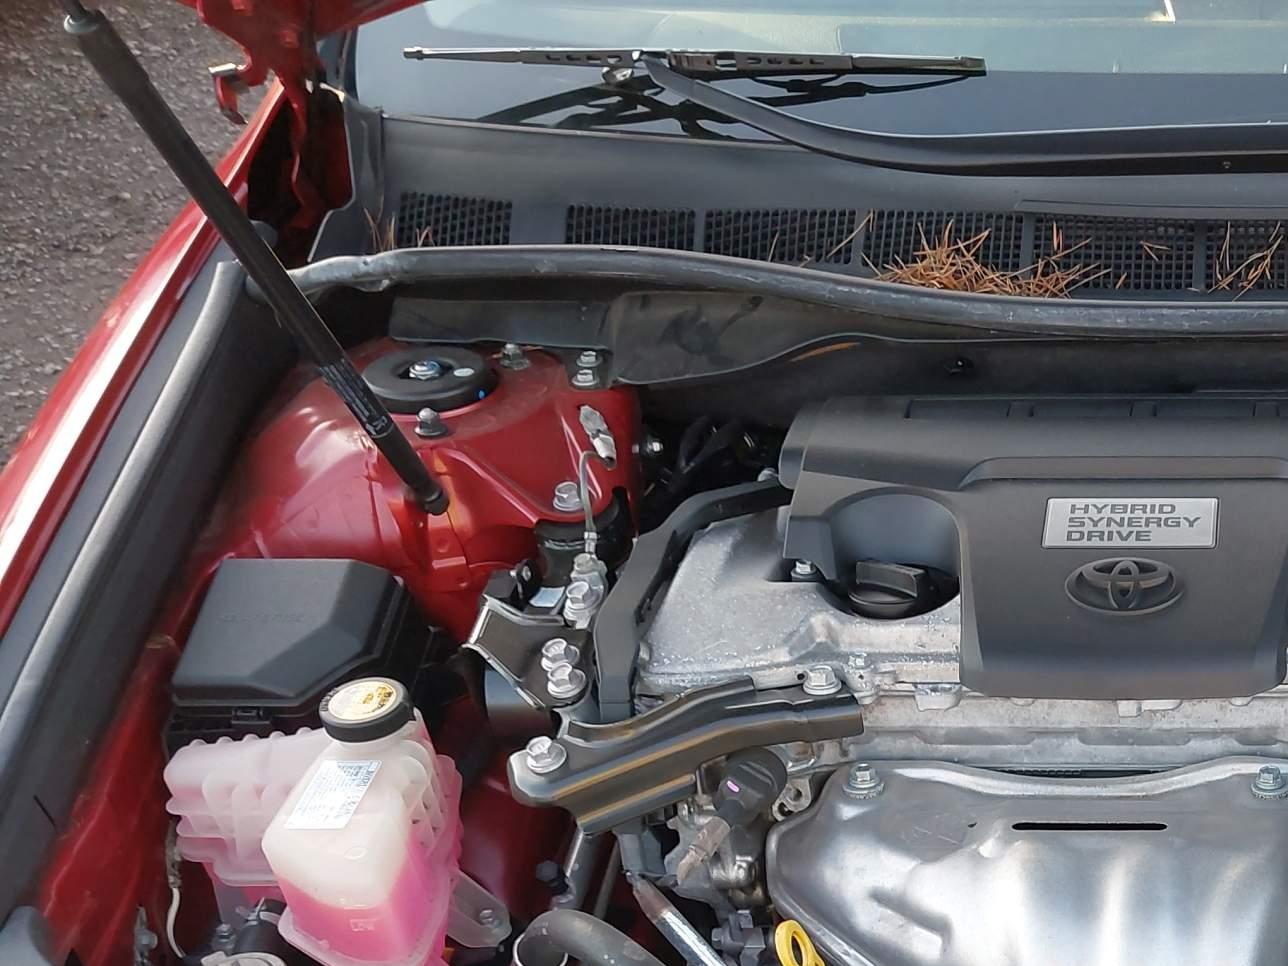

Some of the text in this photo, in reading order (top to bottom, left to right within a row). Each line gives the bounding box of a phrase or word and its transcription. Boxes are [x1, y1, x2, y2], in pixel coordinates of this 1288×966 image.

[1069, 503, 1176, 515] HYBRID
[1067, 516, 1202, 528] SYNERGY
[1066, 530, 1152, 542] DRIVE
